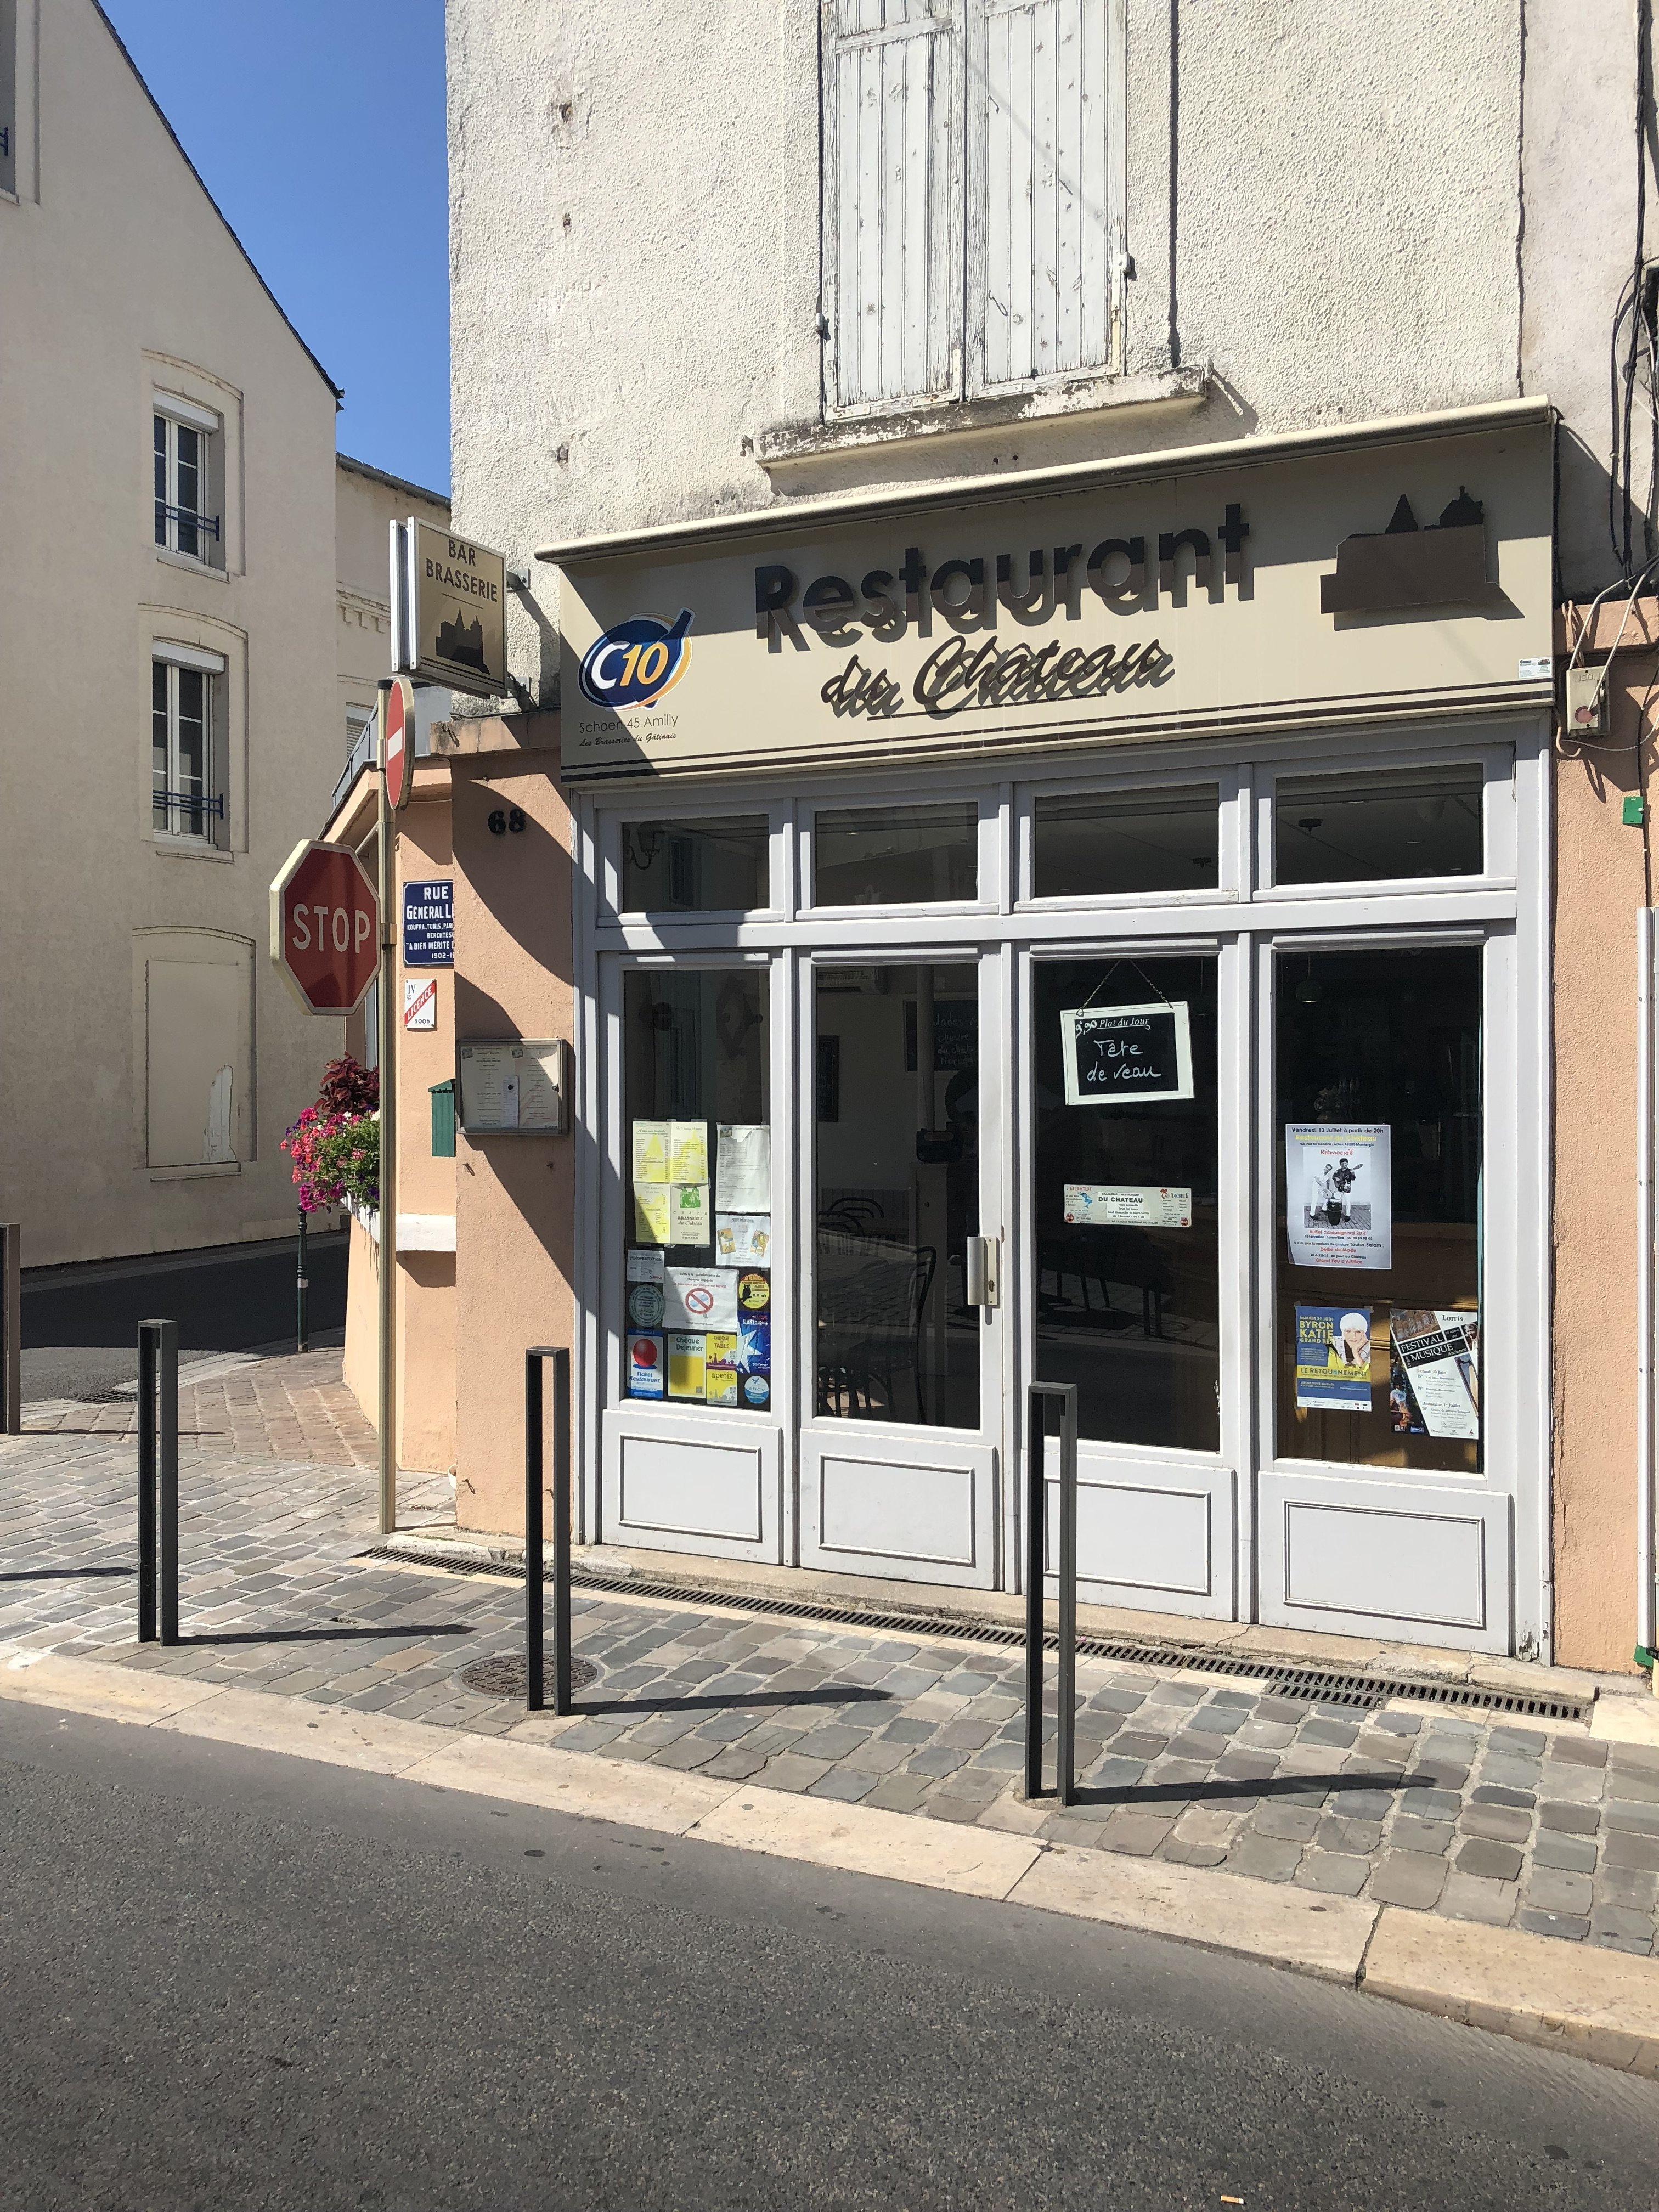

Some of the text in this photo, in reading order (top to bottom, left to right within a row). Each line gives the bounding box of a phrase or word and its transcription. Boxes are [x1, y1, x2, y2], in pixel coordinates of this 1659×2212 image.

[448, 539, 476, 567] BAR
[426, 558, 498, 603] BRASSERIE
[755, 503, 1250, 640] Restaurant
[591, 640, 669, 690] C10
[820, 654, 890, 704] du
[579, 713, 679, 733] Schoen 45 Amilly
[578, 738, 592, 747] Les
[595, 737, 630, 746] Brasseries
[645, 732, 676, 743] Gâtinais
[488, 809, 525, 834] 68
[424, 885, 449, 900] RUE
[292, 903, 370, 953] STOP
[414, 941, 427, 950] BIEN
[408, 984, 416, 994] IV
[408, 985, 432, 1020] LICENCE
[1099, 1017, 1150, 1028] Plat du Jour
[1093, 1039, 1144, 1057] Tête
[1087, 1060, 1108, 1081] de
[1299, 1320, 1334, 1329] BYRON
[1300, 1328, 1334, 1339] KATIE
[676, 1336, 699, 1345] Chèque
[676, 1344, 704, 1352] Déjeuner
[1400, 1334, 1443, 1352] FESTIVAL
[1410, 1343, 1454, 1362] MUSIQUE
[1448, 1348, 1467, 1356] Ancienne
[711, 1372, 733, 1380] apetiz
